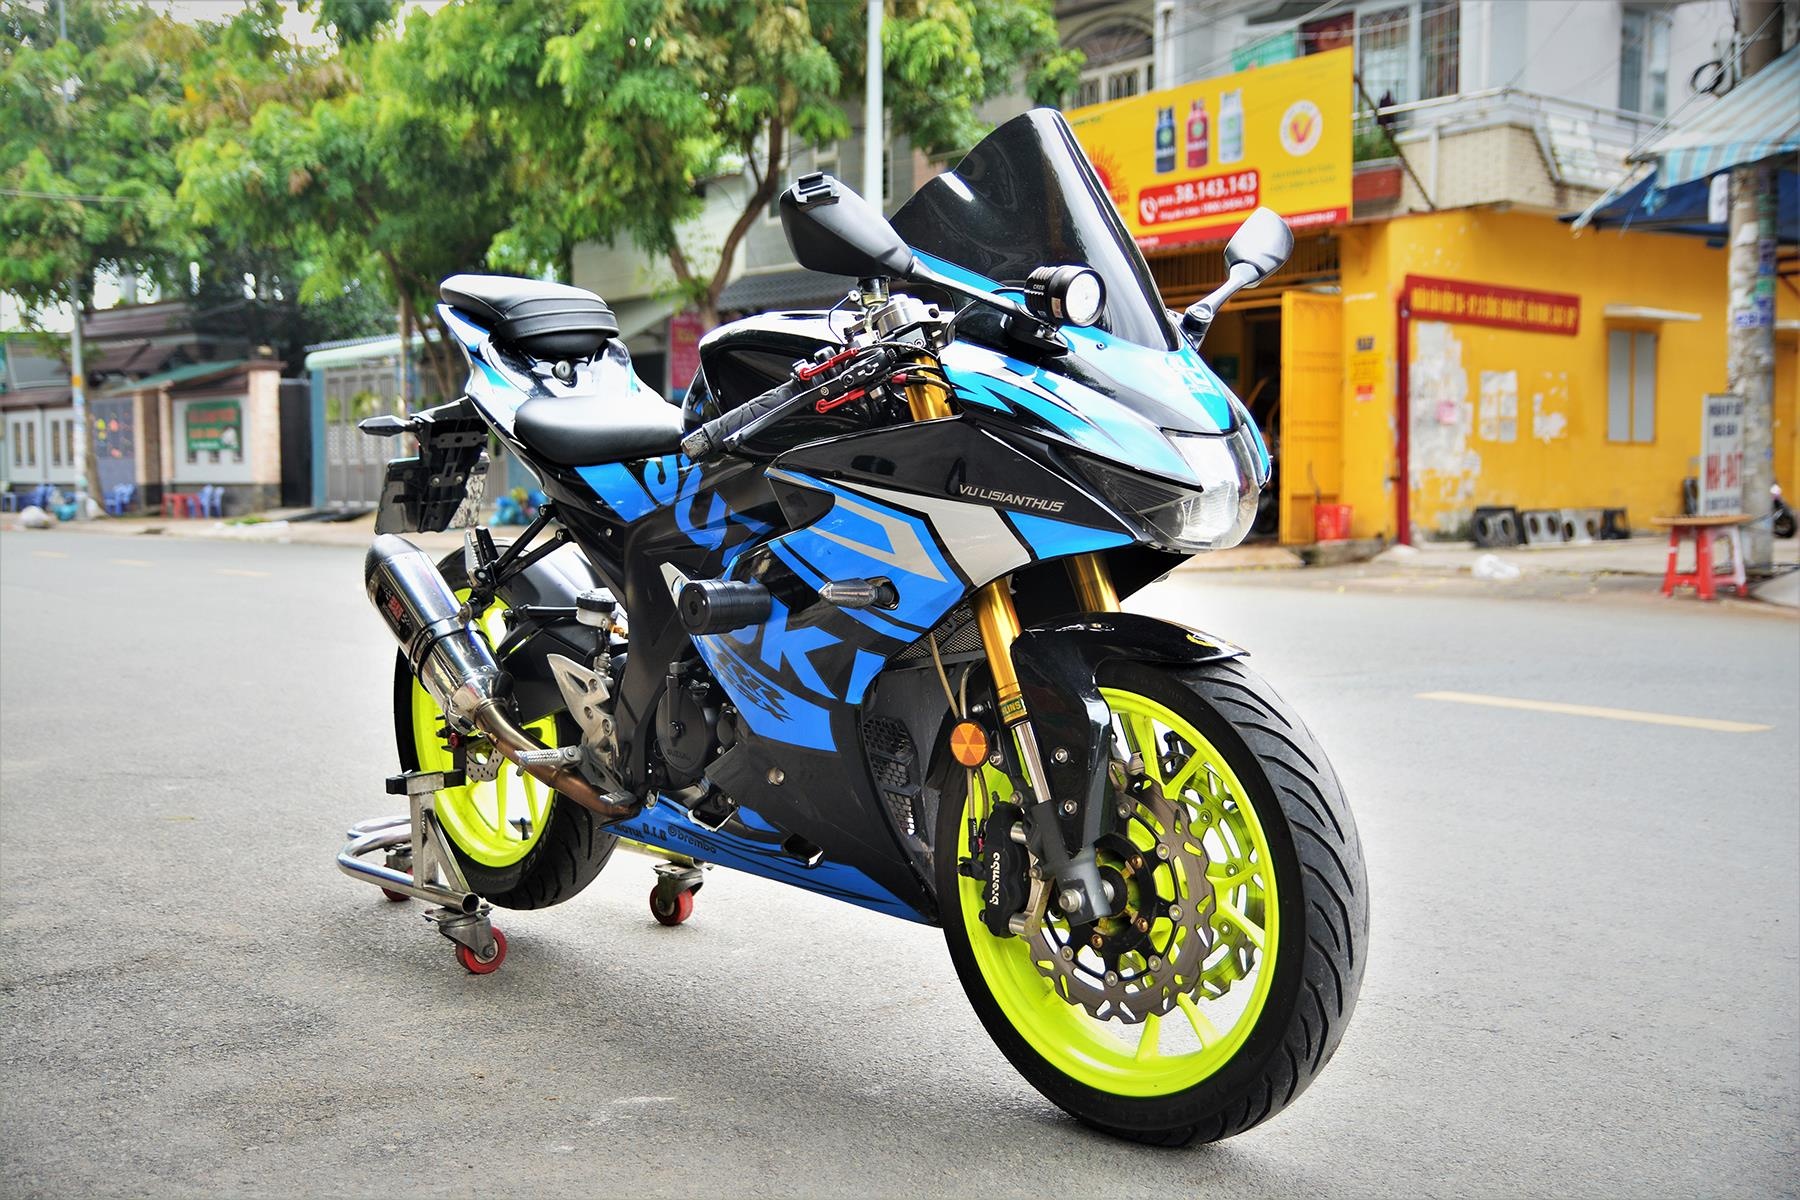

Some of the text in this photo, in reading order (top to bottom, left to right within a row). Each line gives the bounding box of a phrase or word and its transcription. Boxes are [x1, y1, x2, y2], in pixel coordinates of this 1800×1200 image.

[960, 484, 1065, 513] VU LISIANTHUS
[989, 851, 1001, 906] brembo
